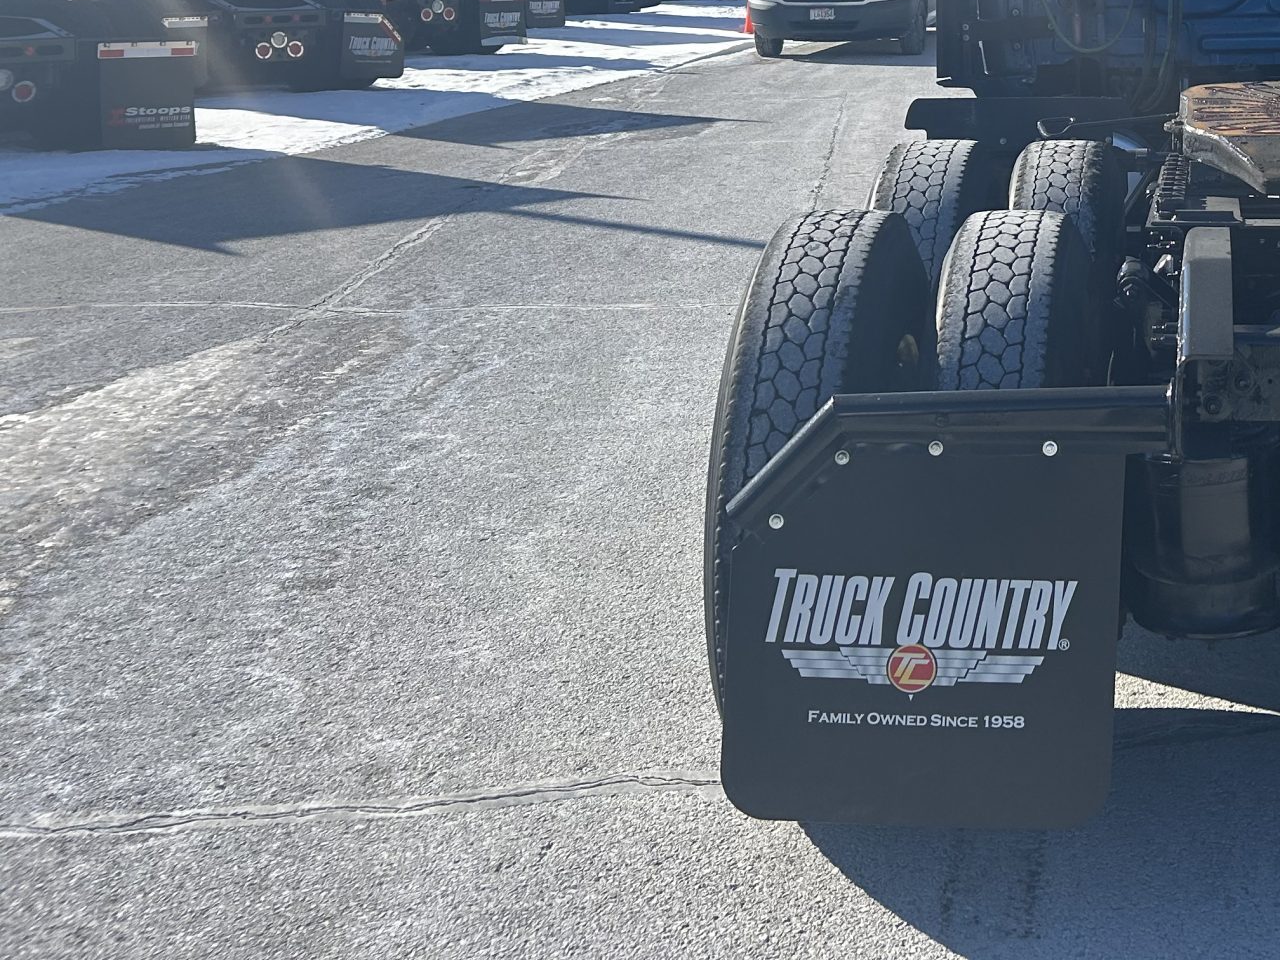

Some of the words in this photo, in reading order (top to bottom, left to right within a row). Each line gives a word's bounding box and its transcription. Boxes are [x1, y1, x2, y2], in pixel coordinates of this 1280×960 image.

[484, 12, 500, 23] TRUCK
[500, 11, 521, 22] COUNTRY
[349, 36, 371, 50] TRUCK
[125, 106, 192, 116] Stoops
[764, 568, 896, 645] TRUCK
[896, 571, 1079, 651] COUNTRY
[807, 710, 865, 725] FAMILY
[867, 712, 928, 727] OWNED
[930, 714, 979, 729] SINCE
[983, 715, 1025, 729] 1958
